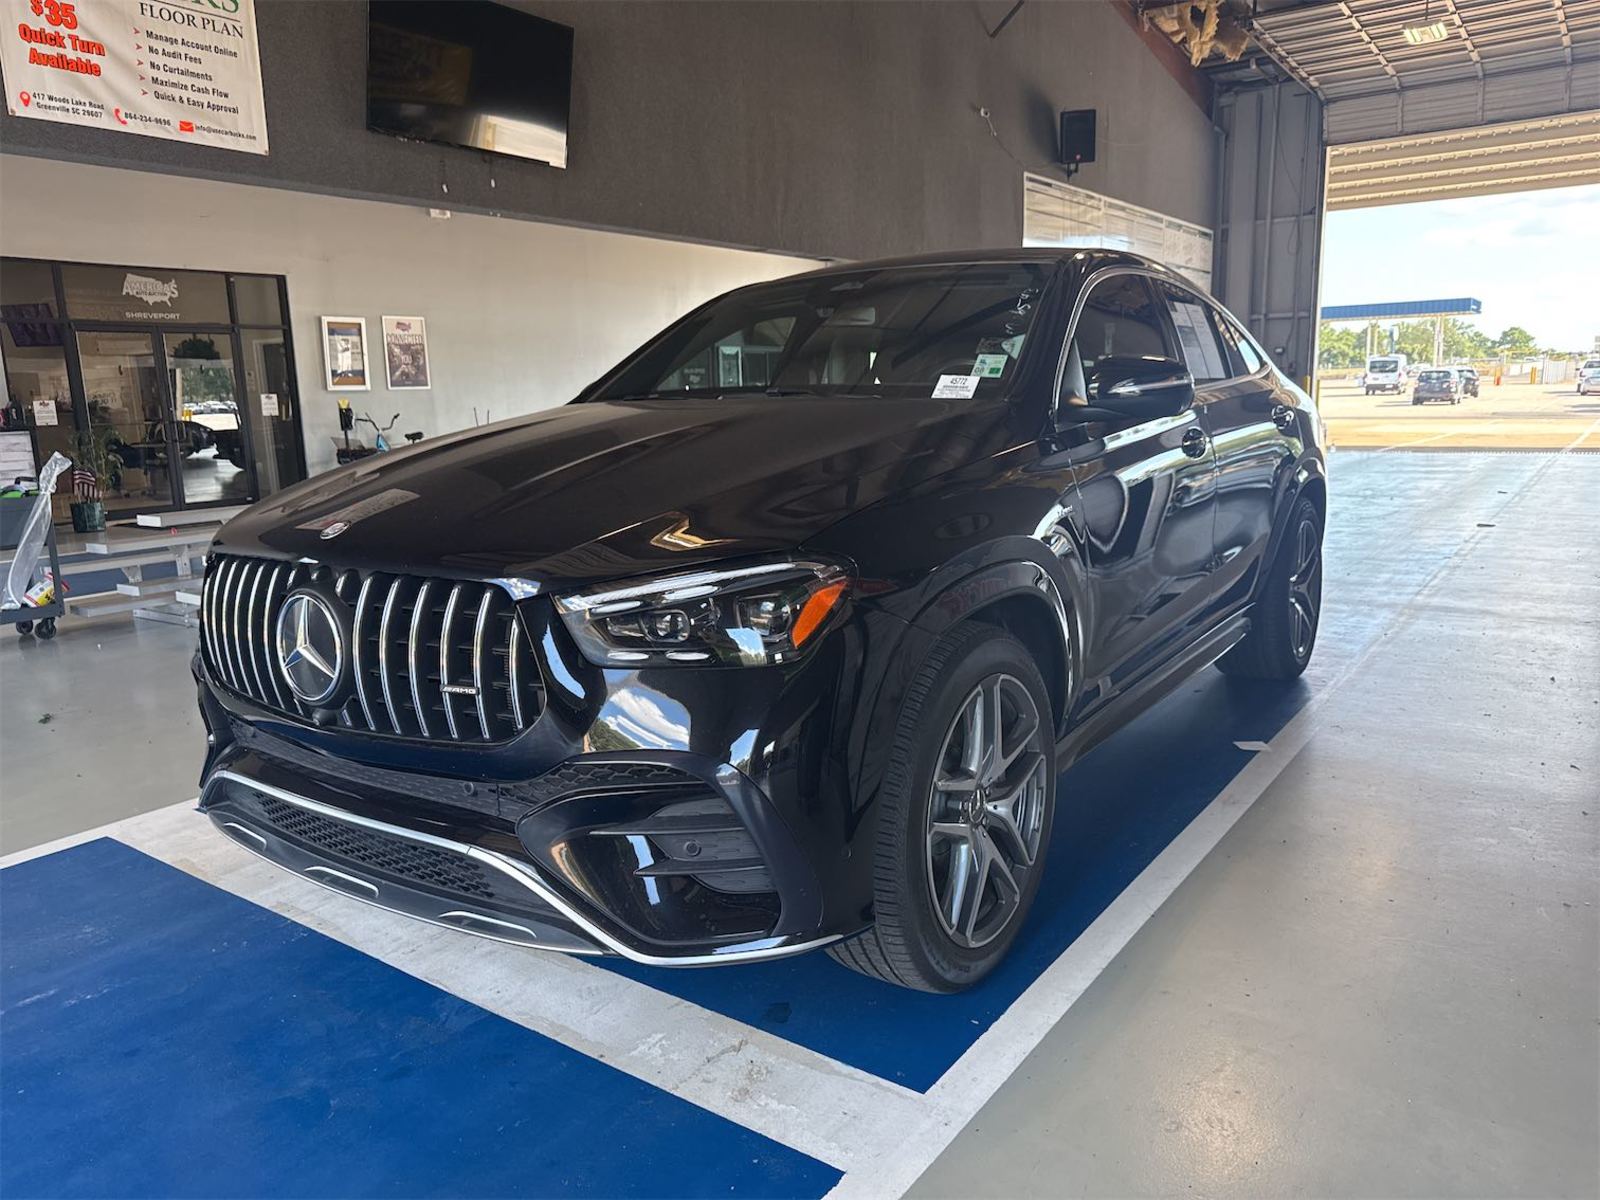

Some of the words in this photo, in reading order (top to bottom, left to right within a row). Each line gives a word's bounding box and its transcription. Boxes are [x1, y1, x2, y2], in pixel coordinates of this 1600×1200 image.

[139, 2, 198, 28] FLOOR
[200, 16, 244, 39] PLAN
[18, 23, 67, 49] Quick
[68, 34, 105, 56] Turn
[146, 30, 179, 46] Manage
[181, 38, 212, 52] Account
[214, 46, 238, 58] Online
[29, 47, 101, 76] Available
[148, 45, 159, 55] No
[162, 48, 182, 60] Audit
[184, 53, 202, 64] Fees
[149, 61, 161, 71] No
[163, 64, 213, 81] Curtailments
[151, 76, 189, 91] Maximize
[191, 84, 210, 96] Cash
[212, 88, 229, 99] Flow
[32, 92, 45, 100] 417
[47, 94, 70, 104] Woods
[71, 98, 87, 107] Lake
[88, 101, 104, 110] Road
[36, 102, 70, 113] Greenville
[71, 107, 80, 115] SC
[153, 90, 177, 103] Quick
[178, 96, 184, 104] &
[186, 97, 204, 109] Easy
[206, 101, 239, 115] Approval
[125, 311, 180, 320] SHREVEPORT
